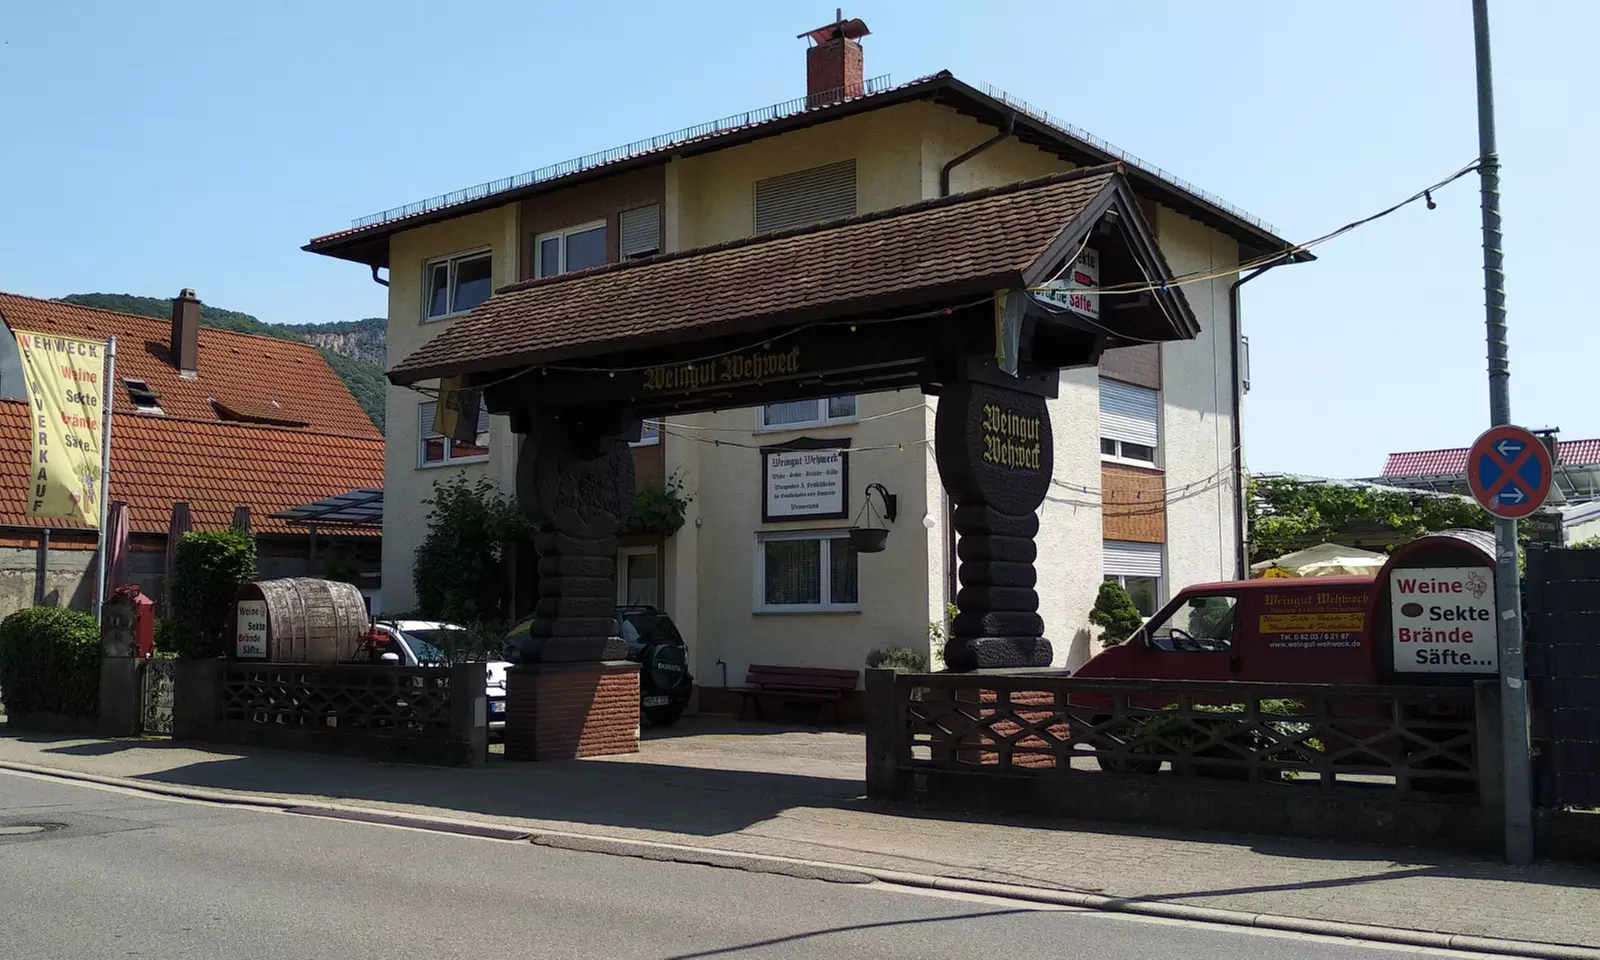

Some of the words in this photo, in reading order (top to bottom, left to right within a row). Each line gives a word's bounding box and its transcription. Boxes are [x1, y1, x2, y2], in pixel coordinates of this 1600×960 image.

[1077, 249, 1096, 269] ekte
[17, 334, 98, 358] WEHWECK
[61, 365, 97, 384] Weine
[643, 359, 717, 390] Weingut
[66, 389, 97, 407] Sekte
[983, 404, 1040, 442] Weingut
[772, 456, 802, 468] Weingut
[804, 453, 839, 465] Wehweck
[983, 434, 1040, 471] Wehweck
[1396, 578, 1463, 594] Weine
[1264, 594, 1313, 607] Weingut
[1316, 592, 1369, 606] Wehweck
[239, 606, 260, 616] Weine
[1429, 605, 1490, 621] Sekte
[248, 621, 266, 631] Sekte
[238, 633, 261, 643] Brände
[1398, 627, 1474, 643] Brände
[1269, 639, 1361, 649] www.weingut-wehweck.de
[1416, 649, 1492, 666] Säfte...
